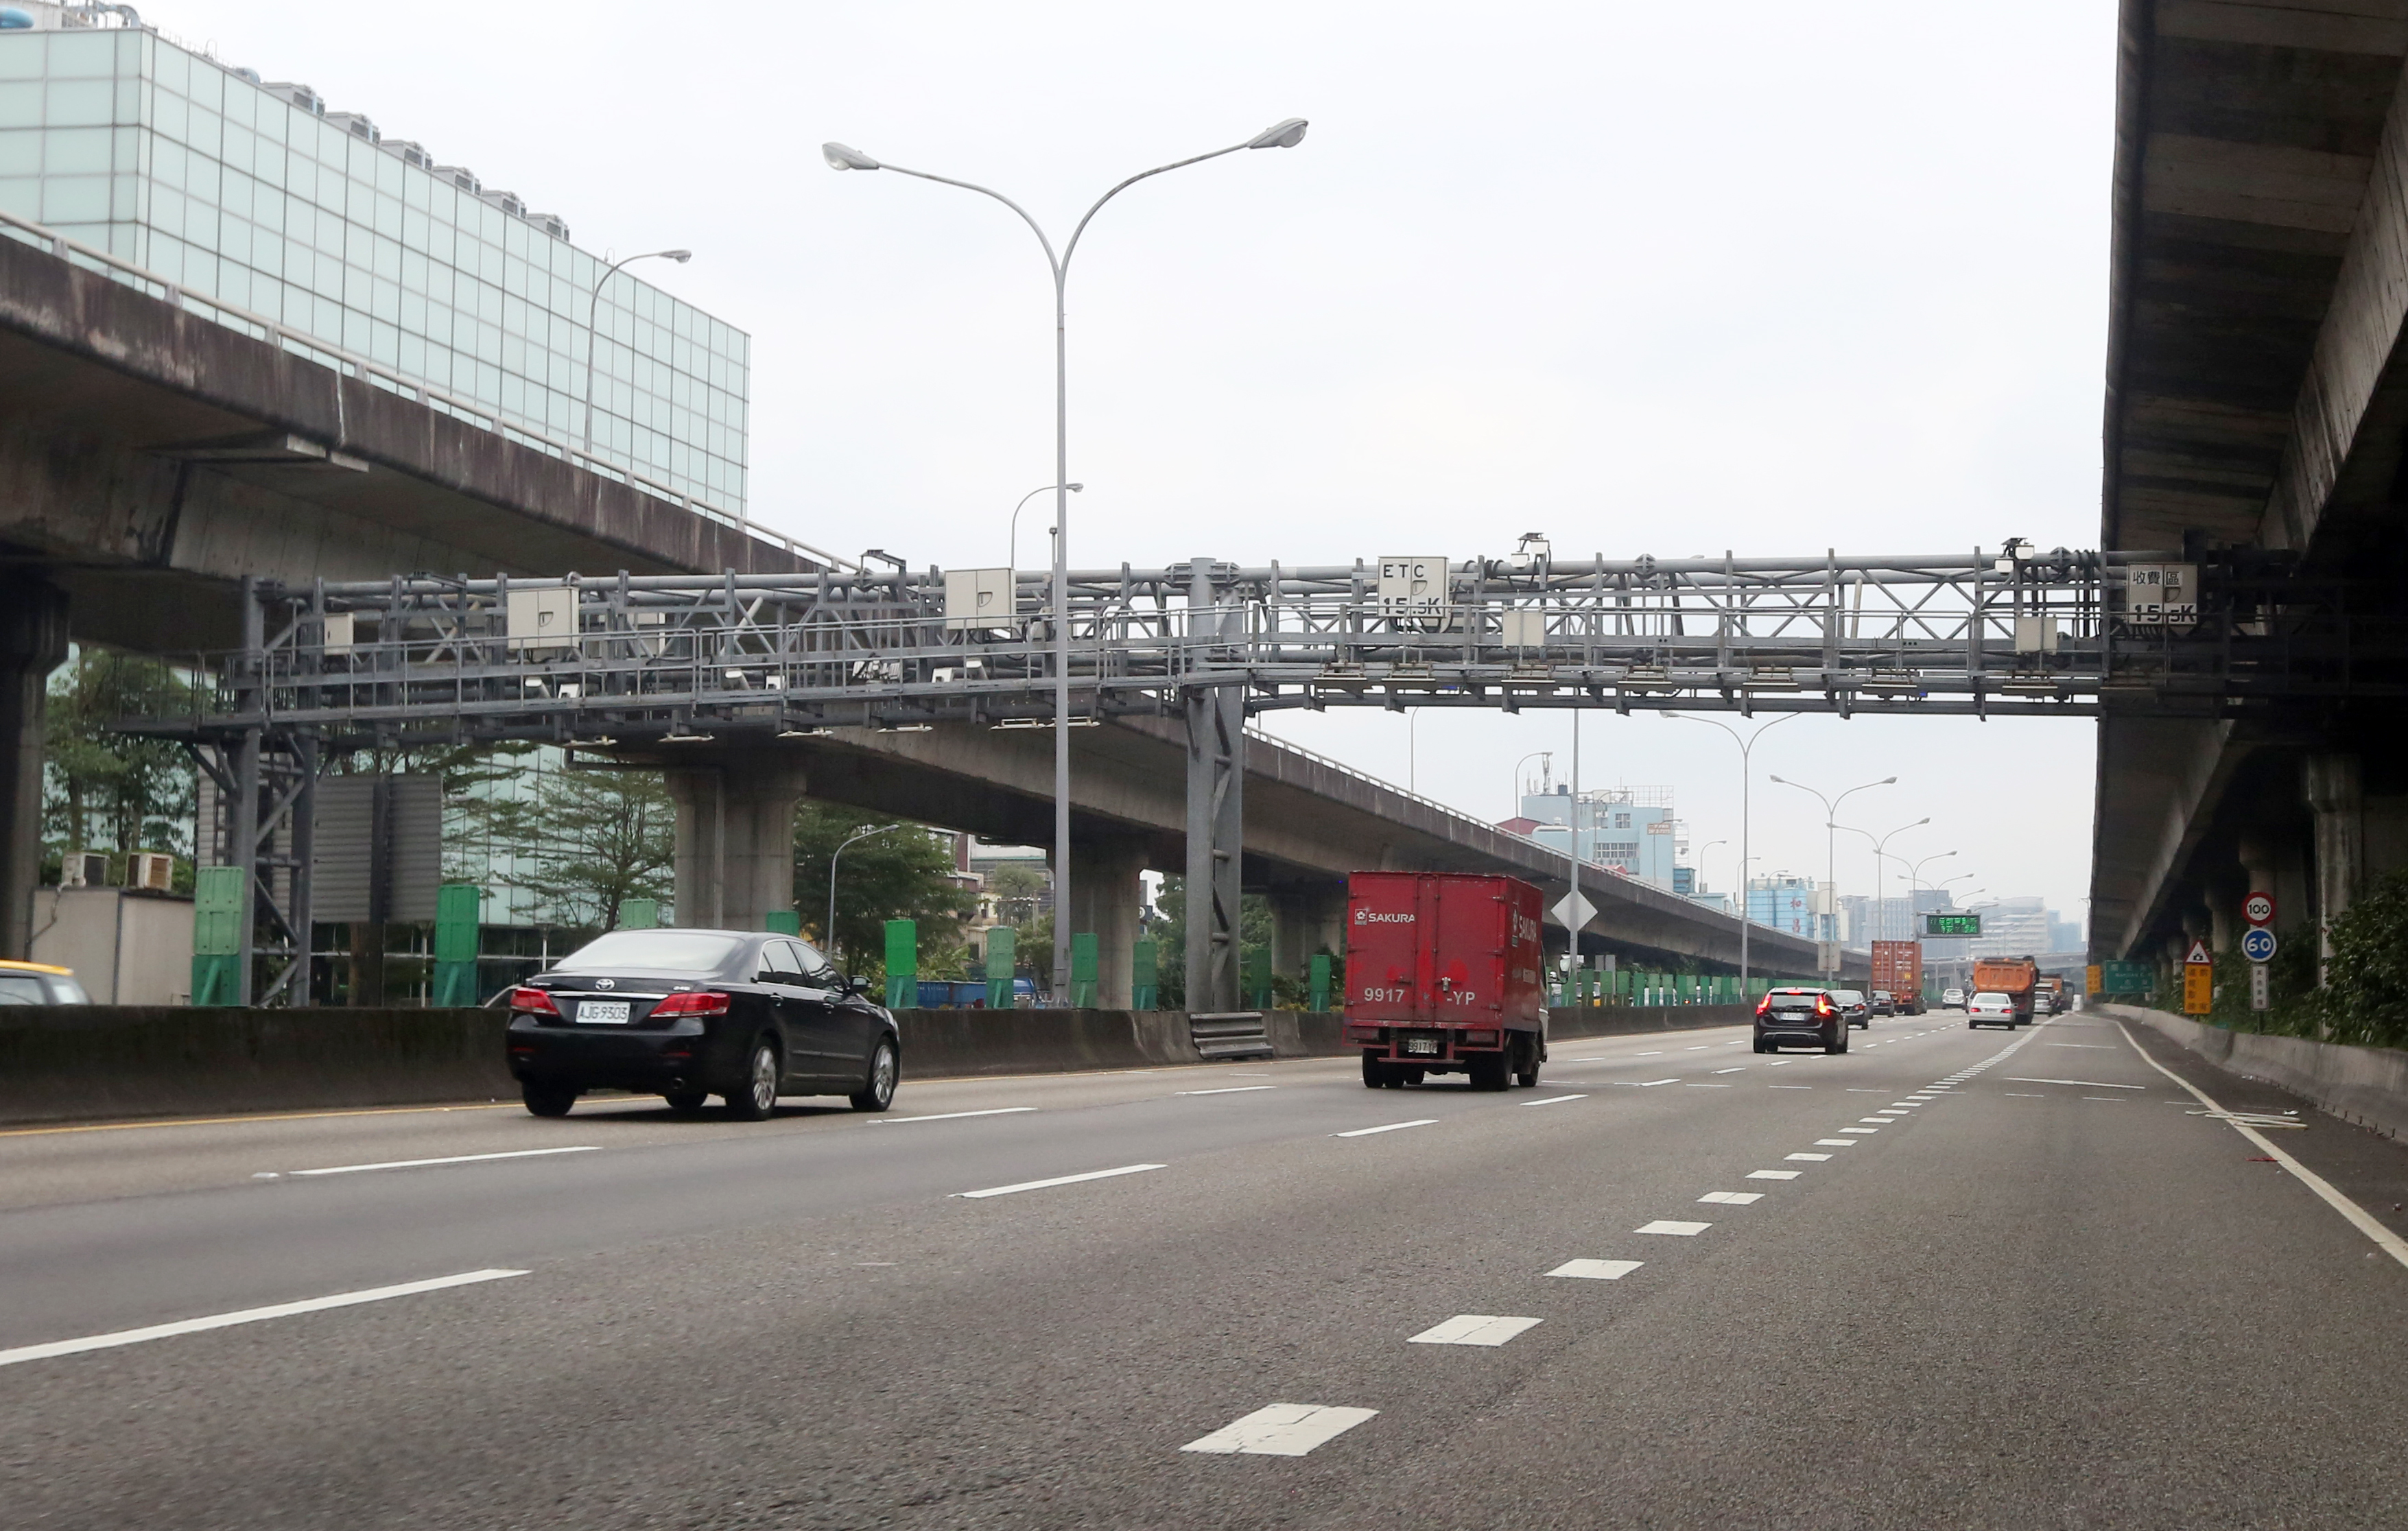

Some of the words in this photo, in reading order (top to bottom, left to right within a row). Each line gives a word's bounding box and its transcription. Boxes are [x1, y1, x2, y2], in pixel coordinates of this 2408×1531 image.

[1383, 564, 1425, 578] ETC
[2132, 571, 2181, 585] 收費區
[2248, 904, 2270, 914] 100
[1368, 913, 1415, 923] SAKURA
[2246, 937, 2272, 952] 60
[1364, 987, 1405, 1003] 9917
